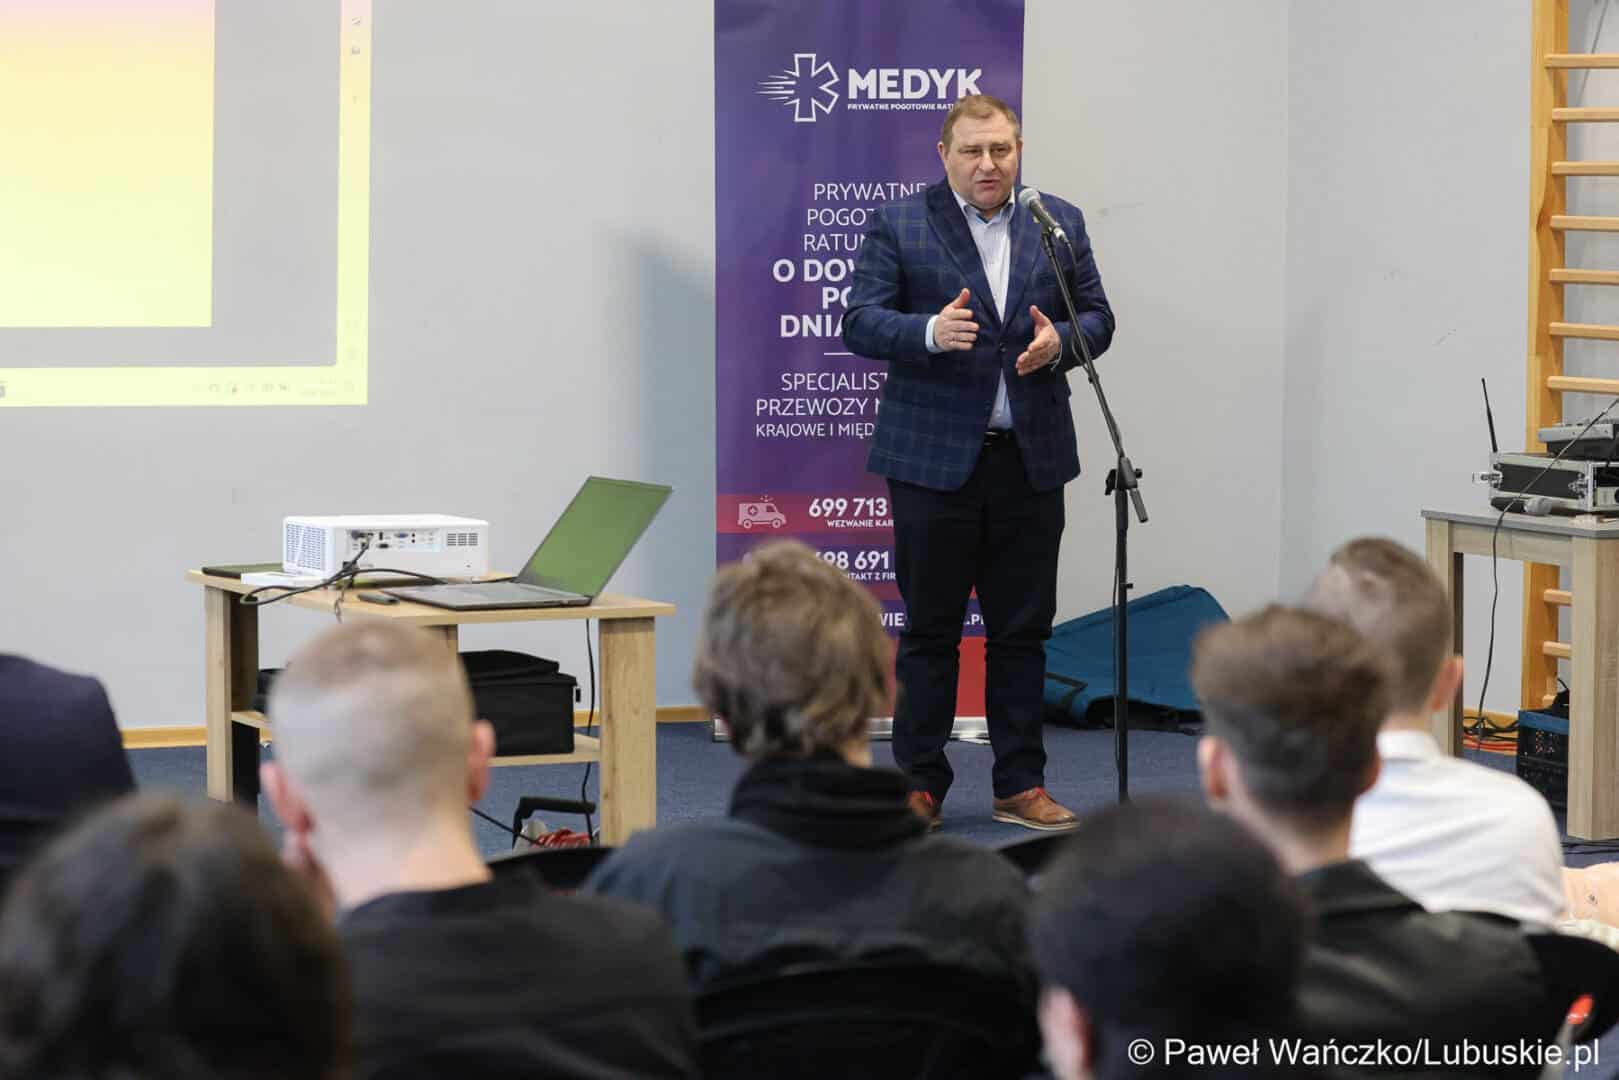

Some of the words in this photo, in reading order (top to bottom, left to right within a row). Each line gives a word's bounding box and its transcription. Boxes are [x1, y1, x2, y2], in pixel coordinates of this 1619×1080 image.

[848, 69, 982, 99] MEDYK
[773, 259, 795, 282] O
[756, 397, 868, 416] PRZEWOZY
[756, 424, 825, 437] KRAJOWE
[830, 424, 833, 436] I
[809, 498, 847, 517] 699
[853, 498, 887, 517] 713
[827, 520, 873, 528] WEZWANIE
[816, 551, 849, 569] 98
[855, 551, 889, 569] 691
